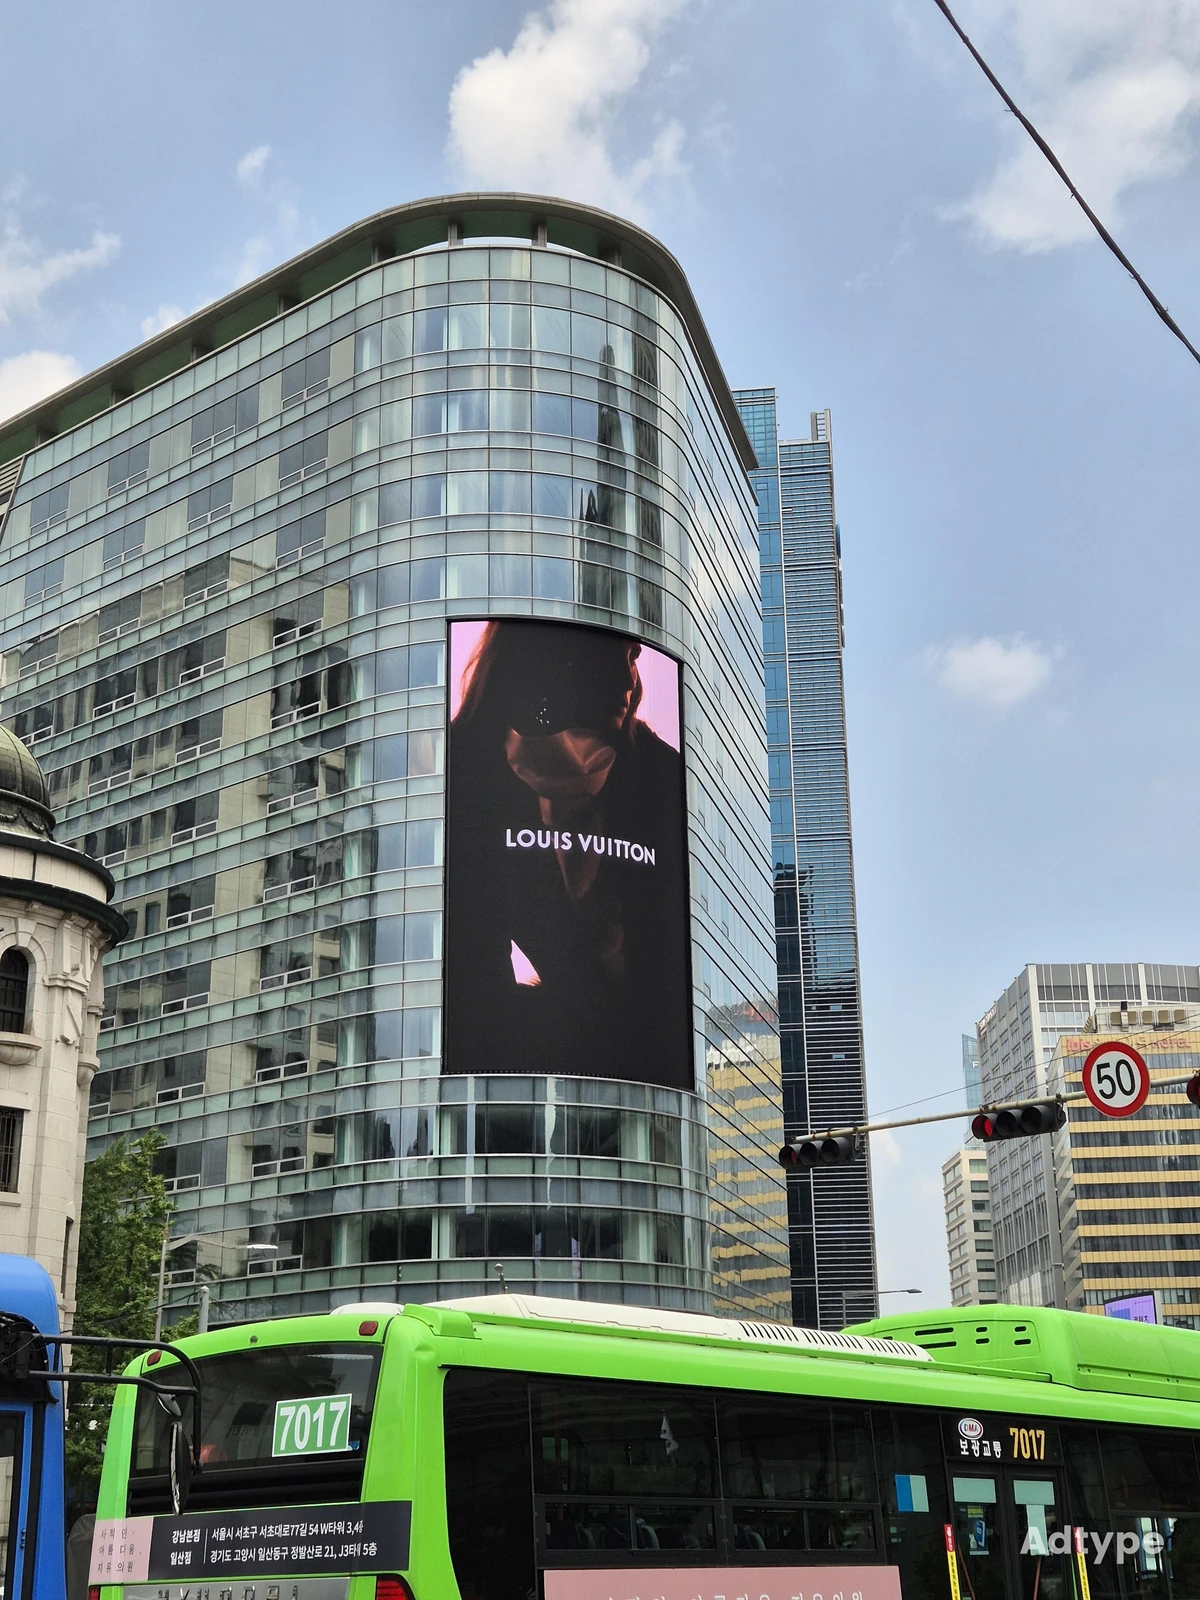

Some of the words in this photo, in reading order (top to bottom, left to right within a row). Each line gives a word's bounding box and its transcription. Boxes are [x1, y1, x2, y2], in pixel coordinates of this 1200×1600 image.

[506, 828, 572, 850] LOUIS
[578, 833, 656, 866] VUITTON
[1096, 1058, 1136, 1100] 50
[278, 1404, 347, 1450] 7017
[1009, 1427, 1045, 1460] 7017
[172, 1528, 201, 1544] 강남본점
[211, 1526, 234, 1541] 서울시
[235, 1525, 258, 1540] 서초구
[259, 1522, 307, 1539] 서초대로77길
[308, 1523, 319, 1536] 54
[320, 1520, 345, 1536] W타워
[170, 1550, 192, 1566] 일산점
[210, 1549, 232, 1563] 경기도
[233, 1547, 256, 1562] 고양시
[257, 1546, 289, 1561] 일산동구
[290, 1544, 323, 1560] 정발산로
[362, 1541, 378, 1557] 5층
